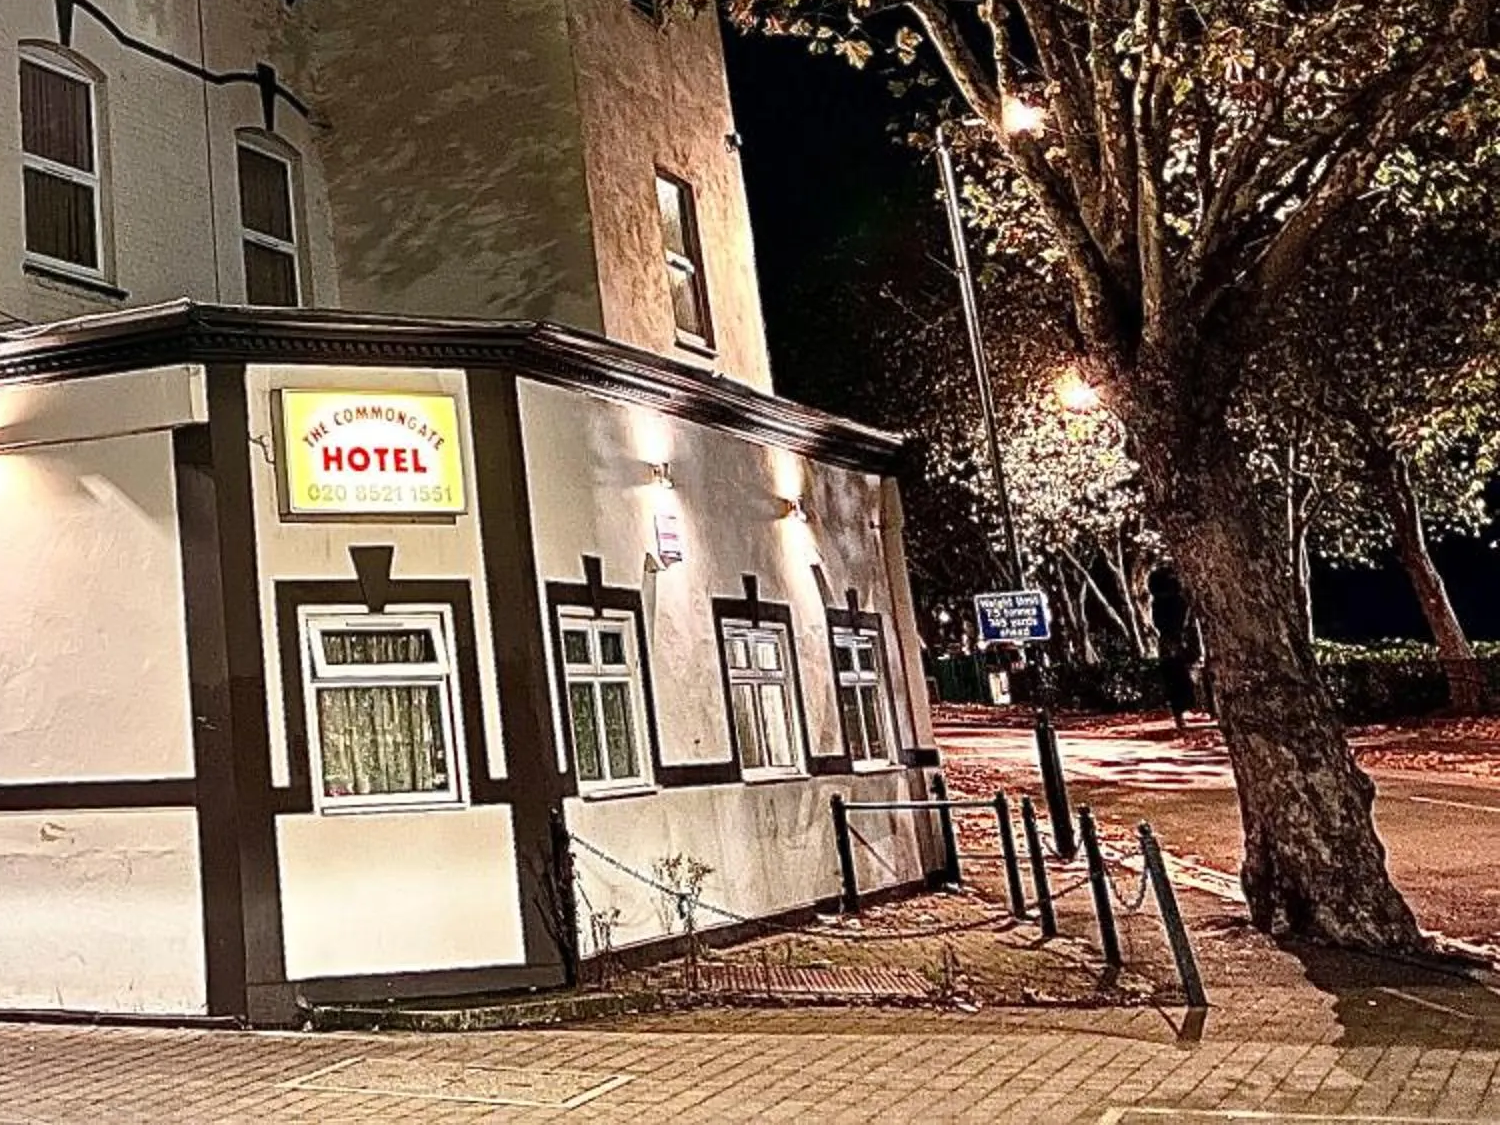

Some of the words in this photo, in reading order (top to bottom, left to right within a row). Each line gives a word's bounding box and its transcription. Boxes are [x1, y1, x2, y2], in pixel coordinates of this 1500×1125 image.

[302, 421, 329, 448] THE
[333, 406, 445, 452] COMMONGATE
[322, 446, 427, 473] HOTEL
[307, 483, 347, 502] 020
[355, 484, 403, 502] 8521
[411, 485, 453, 503] 1551
